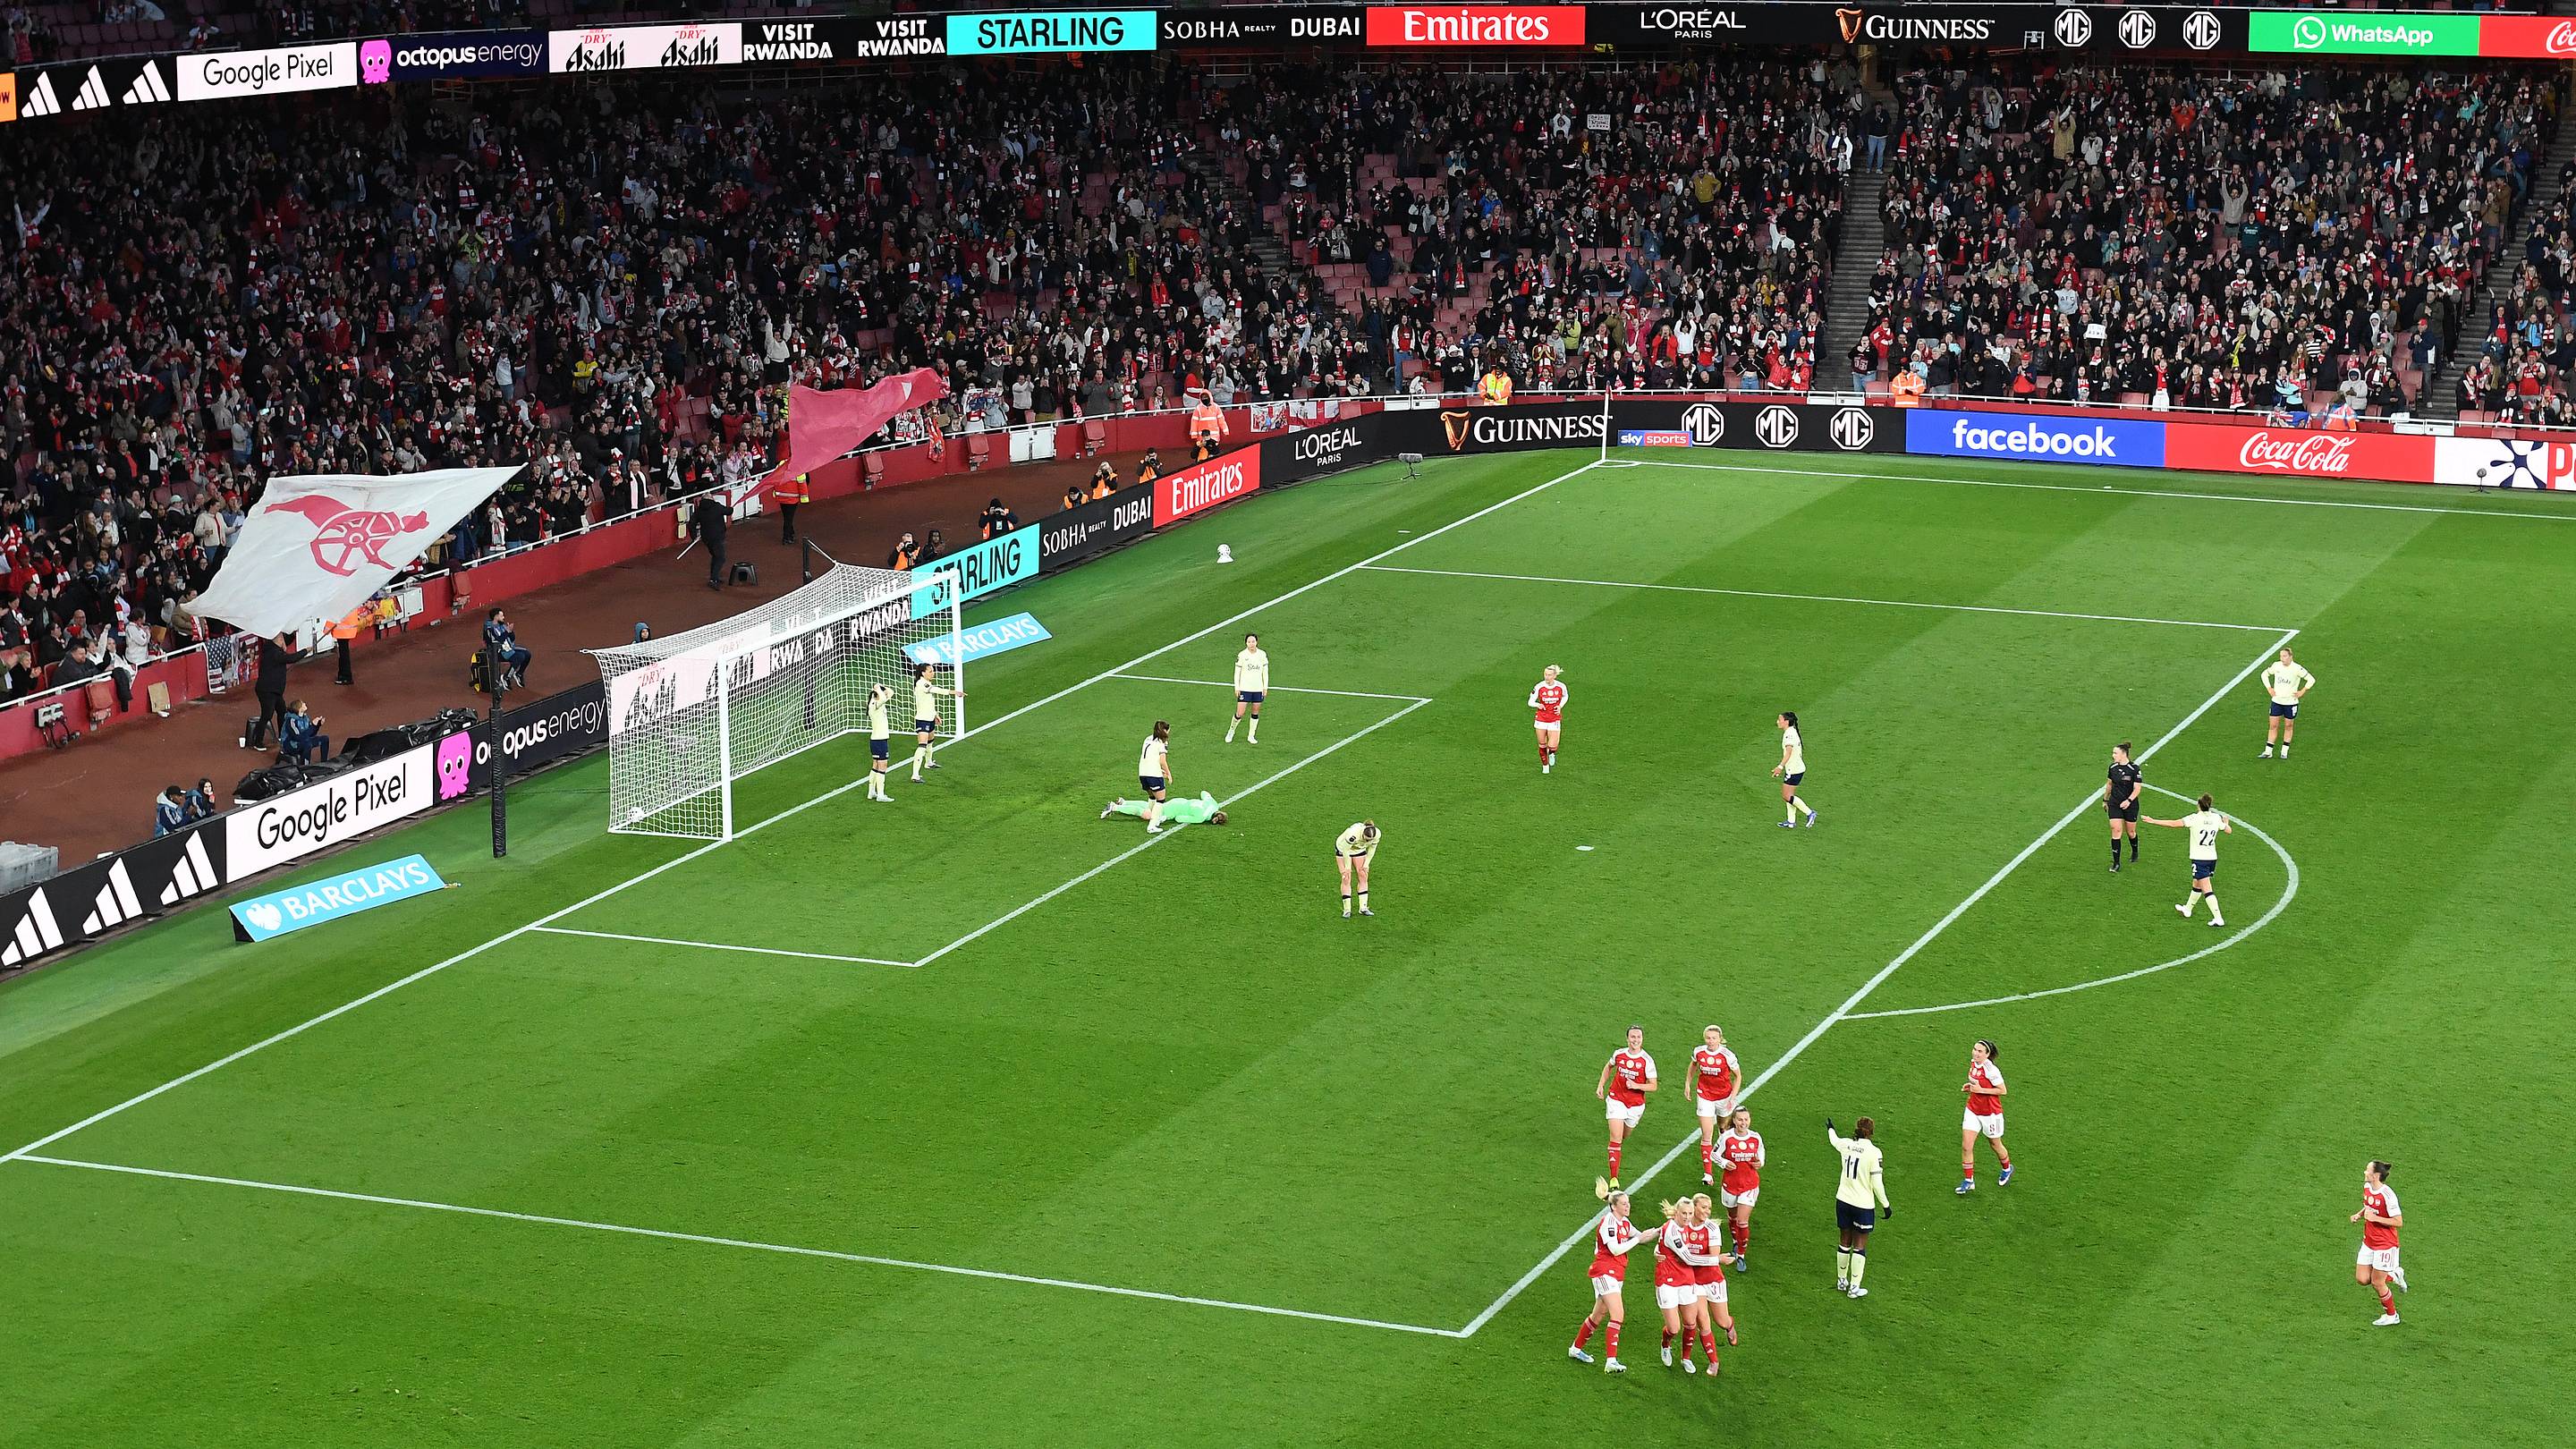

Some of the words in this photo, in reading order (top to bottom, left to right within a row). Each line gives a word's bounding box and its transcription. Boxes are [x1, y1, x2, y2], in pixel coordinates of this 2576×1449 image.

[762, 23, 815, 42] VISIT
[877, 20, 927, 38] VISIT
[978, 16, 1124, 48] STARLING
[1165, 21, 1240, 38] SOBHA
[1291, 18, 1360, 37] DUBAI
[1403, 10, 1549, 41] Emirates
[1674, 30, 1712, 38] PARIS
[2058, 13, 2089, 43] MG
[2123, 14, 2152, 45] MG
[2187, 15, 2217, 46] MG
[2332, 25, 2433, 47] WhatsApp
[397, 47, 476, 69] octopus
[478, 43, 542, 66] energy
[565, 39, 624, 72] Asahi
[660, 36, 718, 67] Asahi
[744, 42, 833, 60] RWANDA
[859, 37, 945, 56] RWANDA
[203, 52, 280, 89] Google
[287, 51, 333, 78] Pixel
[1620, 432, 1644, 445] sky
[1646, 434, 1687, 445] sports
[1686, 407, 1720, 442] MG
[1759, 409, 1794, 444] MG
[1834, 411, 1868, 445] MG
[1953, 419, 2115, 457] facebook
[1317, 453, 1342, 467] PARIS
[1172, 461, 1243, 515] Emirates
[1043, 521, 1087, 556] SOBHA
[1088, 520, 1107, 533] REALTY
[1113, 495, 1152, 531] DUBAI
[771, 628, 834, 672] RWADA
[476, 719, 547, 765] oopus
[548, 698, 606, 738] energy
[258, 791, 346, 850] Google
[353, 763, 407, 816] Pixel
[2199, 829, 2216, 847] 22
[283, 862, 430, 920] BARCLAYS
[1846, 1155, 1860, 1180] 11
